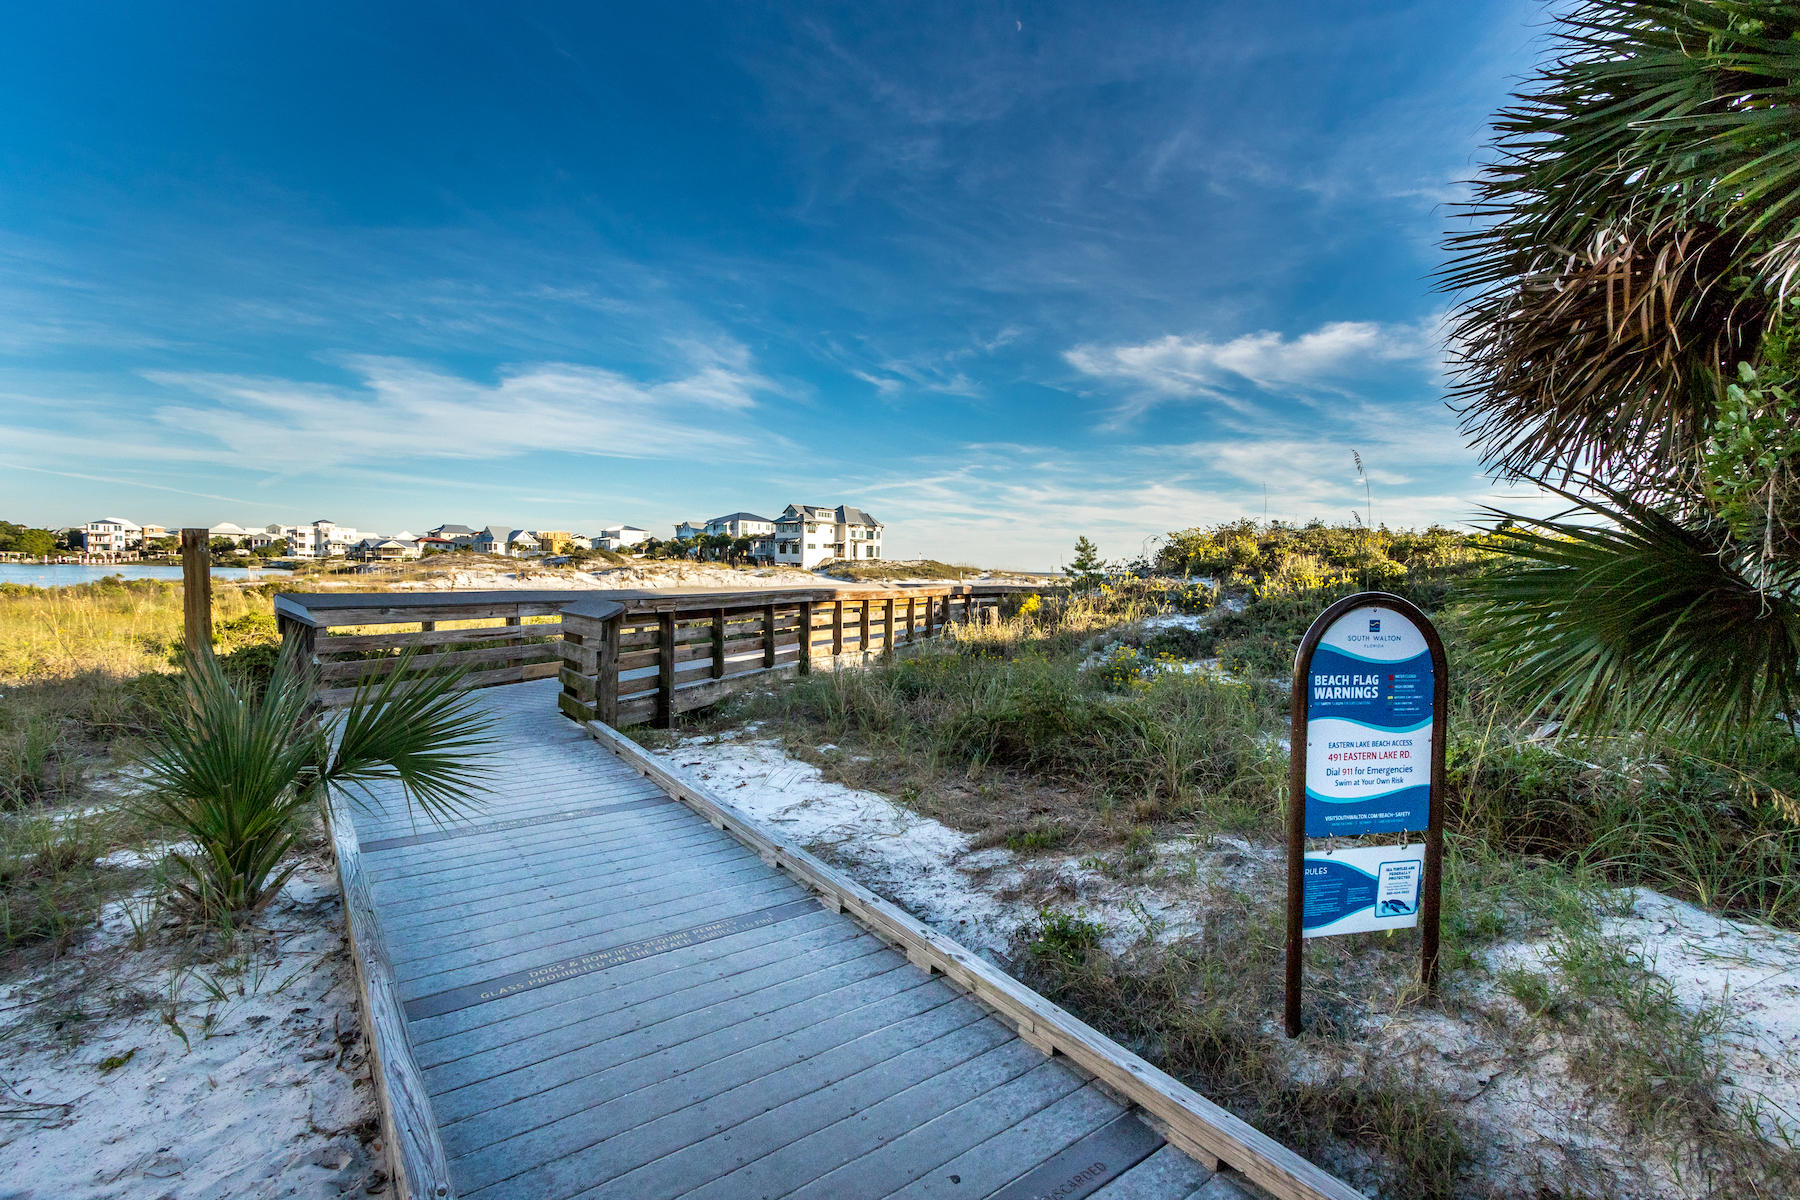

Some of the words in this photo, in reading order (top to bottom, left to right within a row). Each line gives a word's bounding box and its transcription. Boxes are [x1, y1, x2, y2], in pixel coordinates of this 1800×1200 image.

[1314, 674, 1350, 686] BEACH
[1353, 674, 1379, 686] FLAG
[1314, 686, 1379, 699] WARNINGS
[1328, 741, 1354, 749] EASTERN
[1371, 740, 1390, 748] BEACH
[1328, 753, 1342, 762] 491
[1343, 752, 1377, 760] EASTERN
[1379, 751, 1397, 760] LAKE
[1399, 750, 1412, 759] RD.
[1326, 768, 1341, 776] Dial
[1354, 766, 1365, 775] for
[1367, 764, 1413, 776] Emergencies
[1335, 779, 1352, 787] Swim
[1376, 777, 1390, 785] Own
[1391, 776, 1404, 784] Risk
[1304, 867, 1328, 876] RULES
[528, 965, 566, 978] DOGS
[581, 944, 640, 964] BONFIRES
[644, 932, 689, 949] REQUIRE
[692, 919, 737, 935] PERMITS
[480, 982, 525, 999] GLASS
[528, 961, 605, 986] PROHIBITED
[608, 954, 627, 964] ON
[655, 937, 692, 952] BEACH
